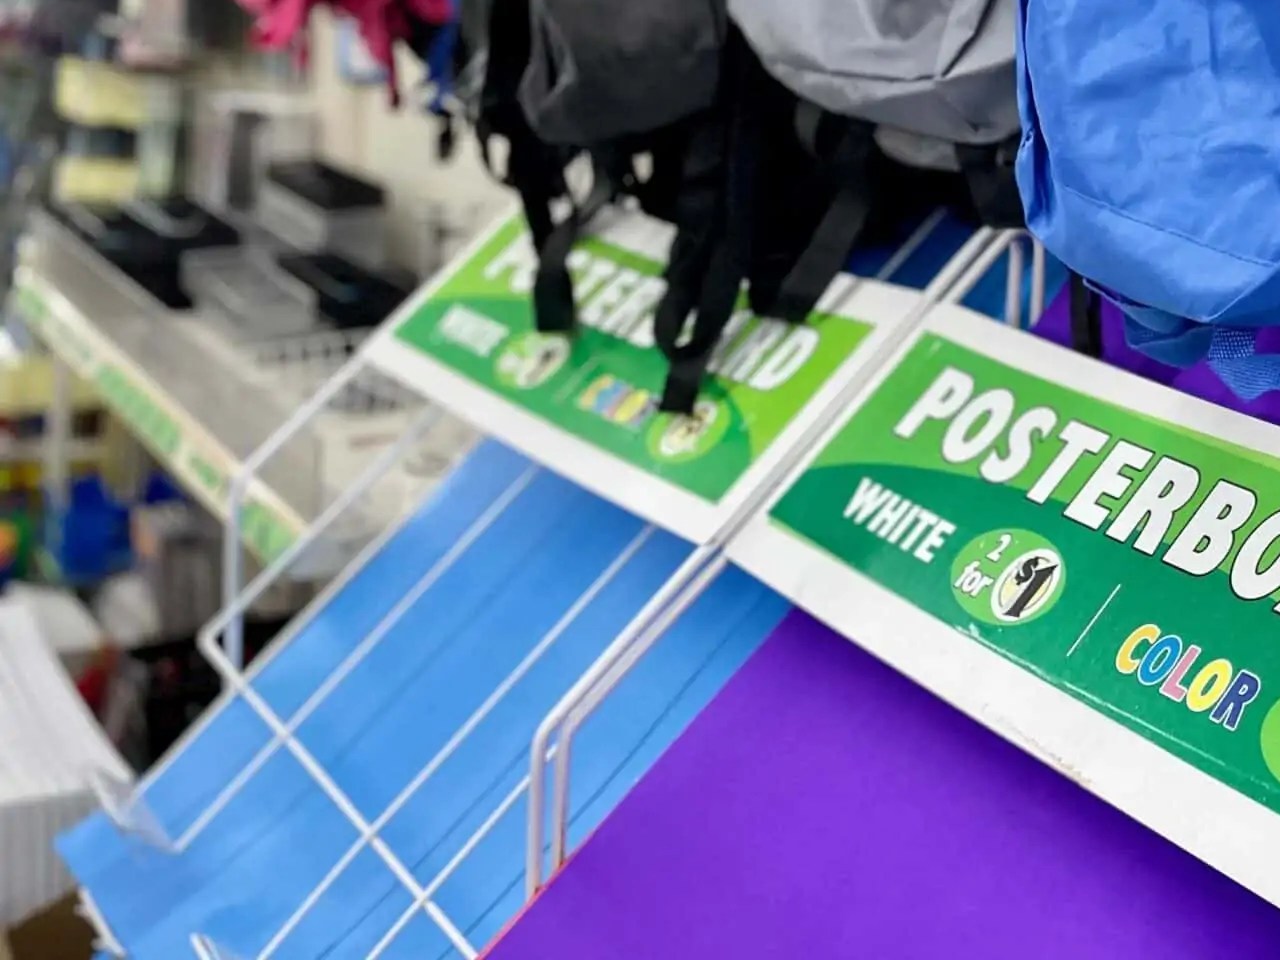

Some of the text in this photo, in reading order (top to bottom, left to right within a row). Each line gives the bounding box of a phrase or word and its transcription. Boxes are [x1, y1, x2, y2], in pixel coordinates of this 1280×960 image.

[843, 476, 957, 563] WHITE
[986, 533, 1013, 562] 2
[953, 555, 1060, 618] for $1
[1115, 623, 1262, 732] COLOR
